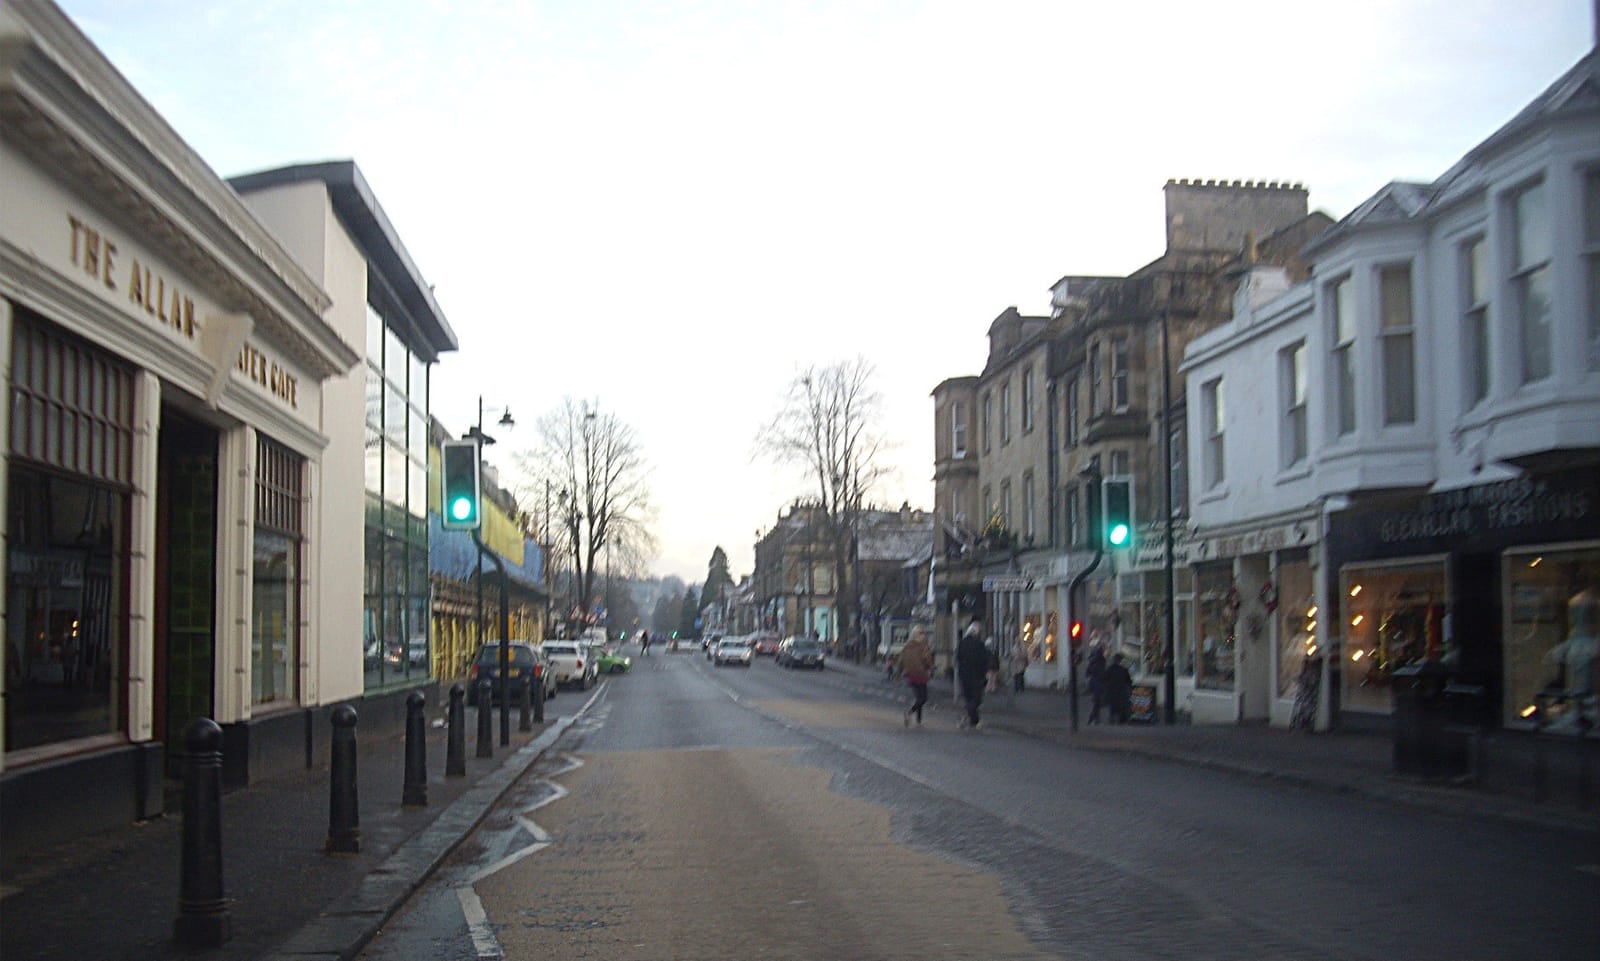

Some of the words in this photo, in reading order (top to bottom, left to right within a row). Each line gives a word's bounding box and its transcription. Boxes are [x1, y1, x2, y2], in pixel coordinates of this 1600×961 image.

[68, 214, 118, 289] THE
[129, 260, 195, 339] ALLAN
[270, 359, 298, 409] CAFE
